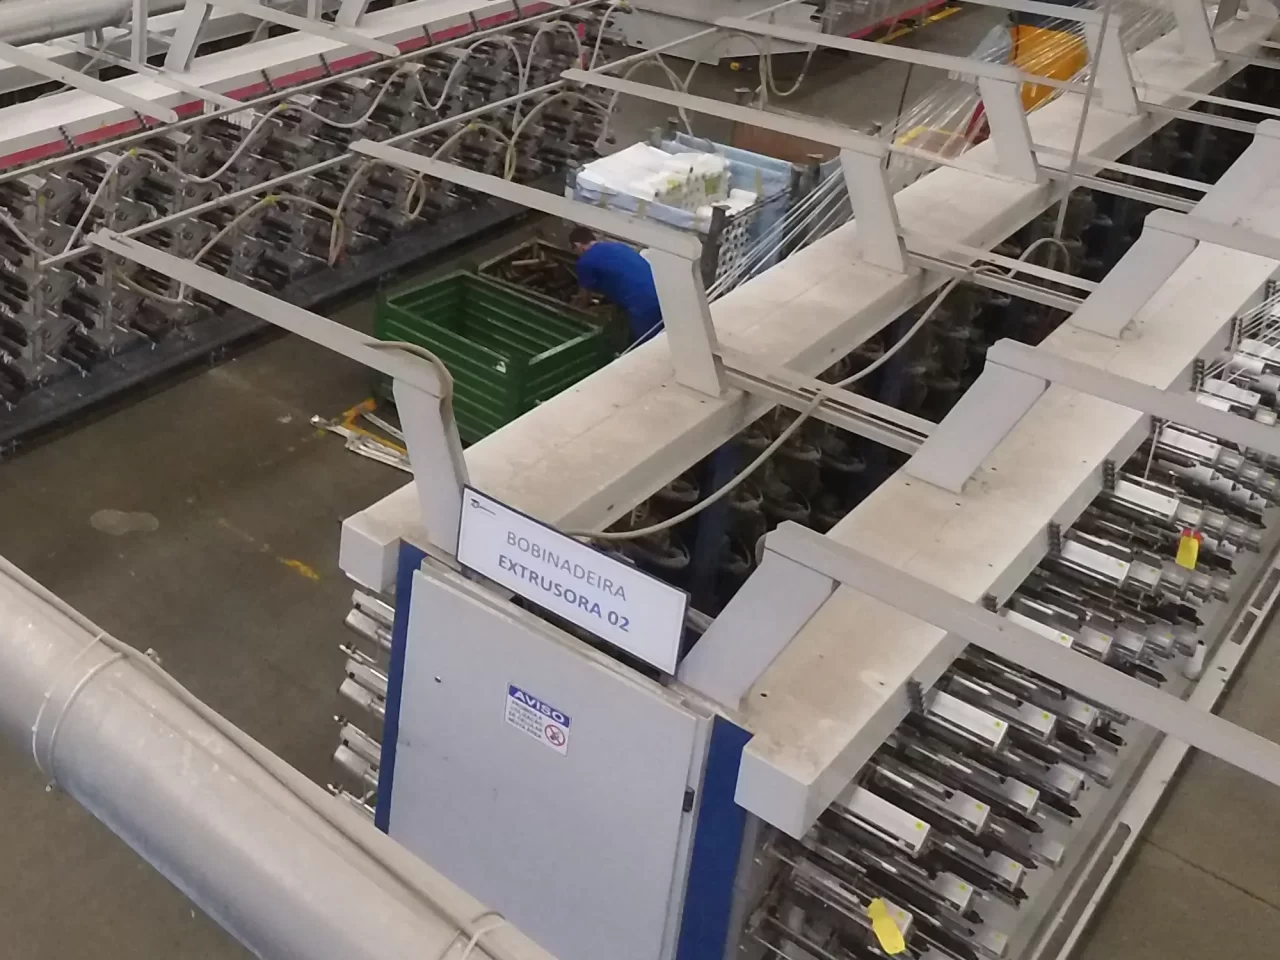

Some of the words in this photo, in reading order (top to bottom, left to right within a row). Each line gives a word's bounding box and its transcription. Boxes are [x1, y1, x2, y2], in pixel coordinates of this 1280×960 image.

[498, 554, 602, 619] EXTRUSORA
[607, 610, 630, 633] 02
[506, 530, 627, 602] BOBINADEIRA
[513, 690, 565, 723] AVISO
